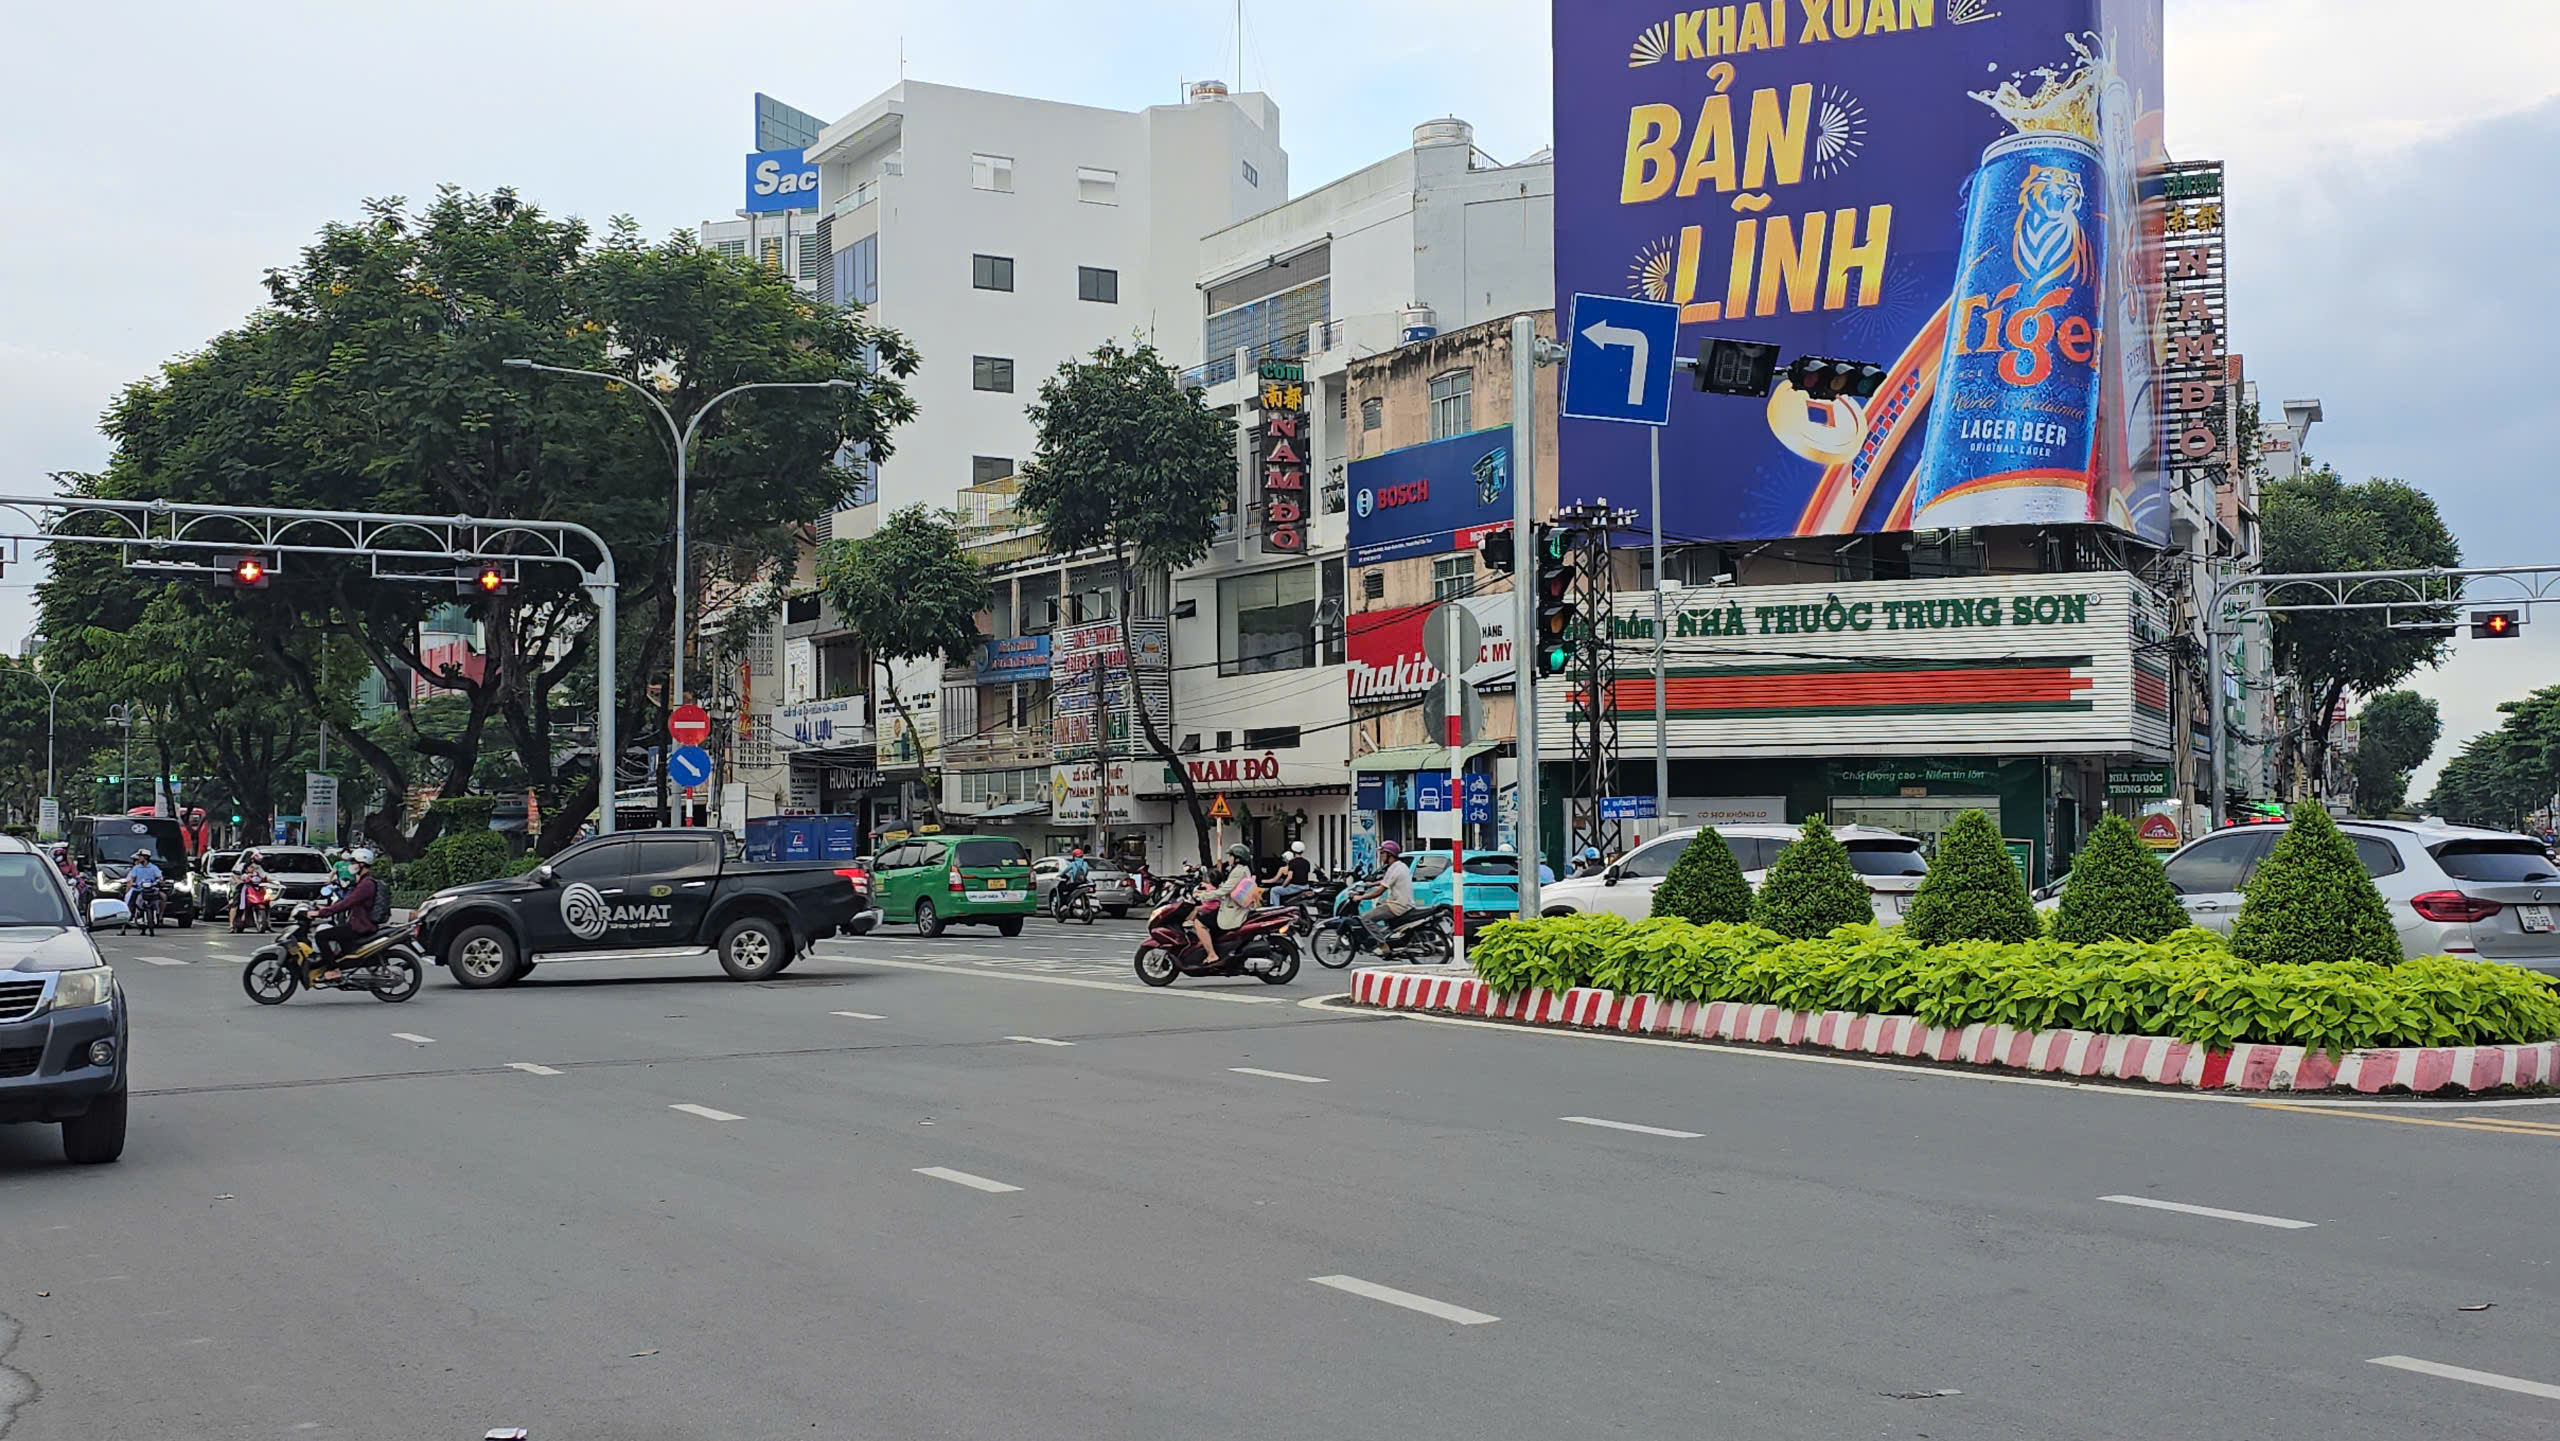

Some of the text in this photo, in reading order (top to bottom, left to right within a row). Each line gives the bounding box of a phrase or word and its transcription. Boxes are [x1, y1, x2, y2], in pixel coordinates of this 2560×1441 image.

[1674, 0, 1786, 61] KHAI
[1620, 61, 1814, 204] BẢN
[1673, 193, 1893, 324] LĨNH
[2174, 249, 2217, 364] NAM
[1961, 419, 2067, 447] LAGER BEER
[1267, 418, 1304, 490] NAM
[1970, 441, 2051, 457] ORIGINAL LAGER
[1377, 479, 1429, 510] BOSCH
[1482, 622, 1503, 639] HÀNG
[1676, 600, 1746, 637] NHÀ
[1883, 598, 2003, 630] TRUNG
[1188, 750, 1280, 783] NAM ĐÔ
[1898, 772, 1916, 780] cao
[2109, 771, 2130, 782] NHÀ
[2109, 785, 2142, 794] TRUNG
[569, 904, 672, 922] PARAMAT
